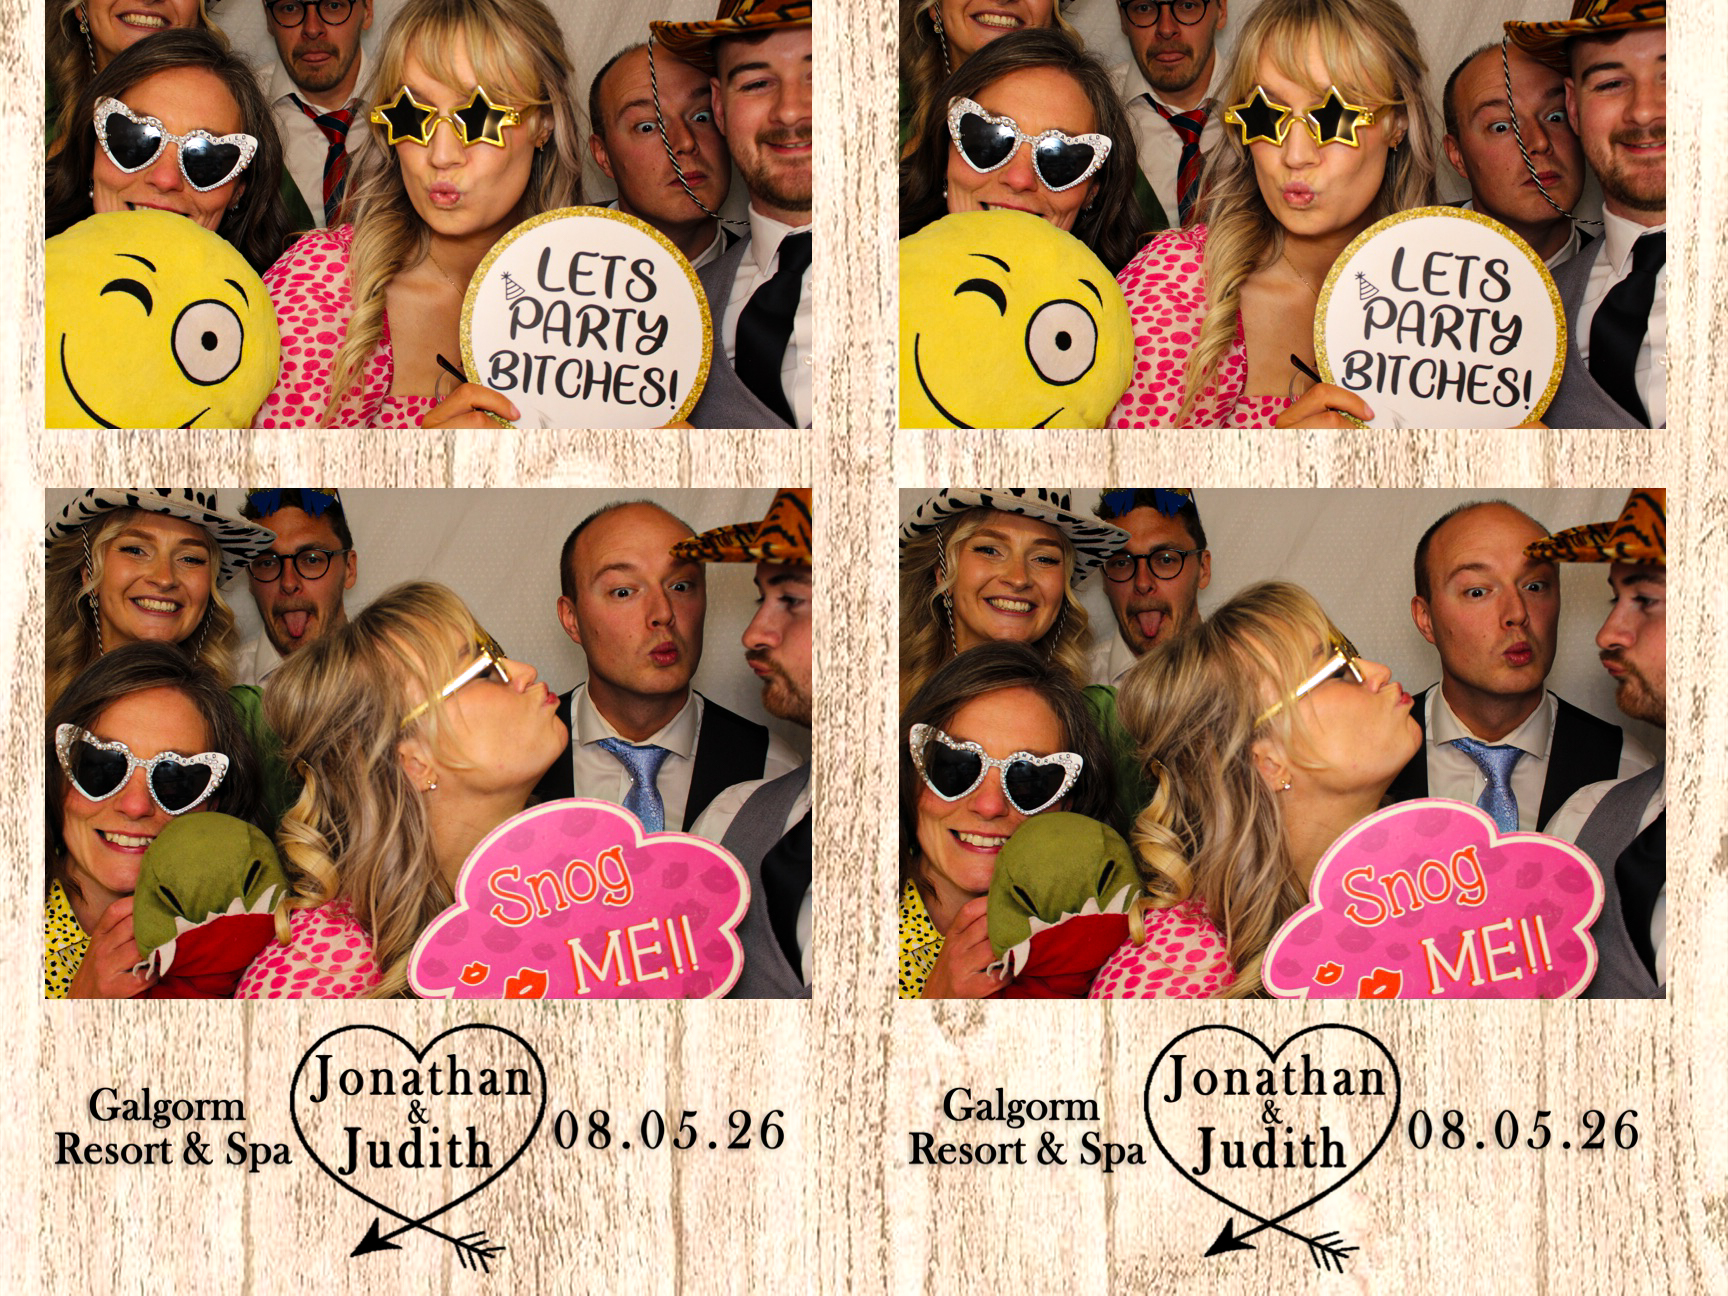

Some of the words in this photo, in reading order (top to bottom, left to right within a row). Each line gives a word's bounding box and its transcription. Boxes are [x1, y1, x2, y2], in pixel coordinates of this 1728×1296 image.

[199, 131, 246, 143] MARRIED
[1053, 131, 1100, 143] MARRIED
[537, 246, 658, 303] LETS
[1391, 246, 1512, 303] LETS
[508, 295, 669, 356] PARTY
[1362, 295, 1523, 356] PARTY
[487, 349, 679, 410] BITCHES!
[1341, 349, 1533, 410] BITCHES!
[168, 753, 217, 764] MARRIED
[1022, 753, 1071, 764] MARRIED
[488, 845, 634, 928] Snog
[1342, 845, 1488, 928] Snog
[564, 914, 699, 995] ME!!
[1418, 914, 1553, 995] ME!!
